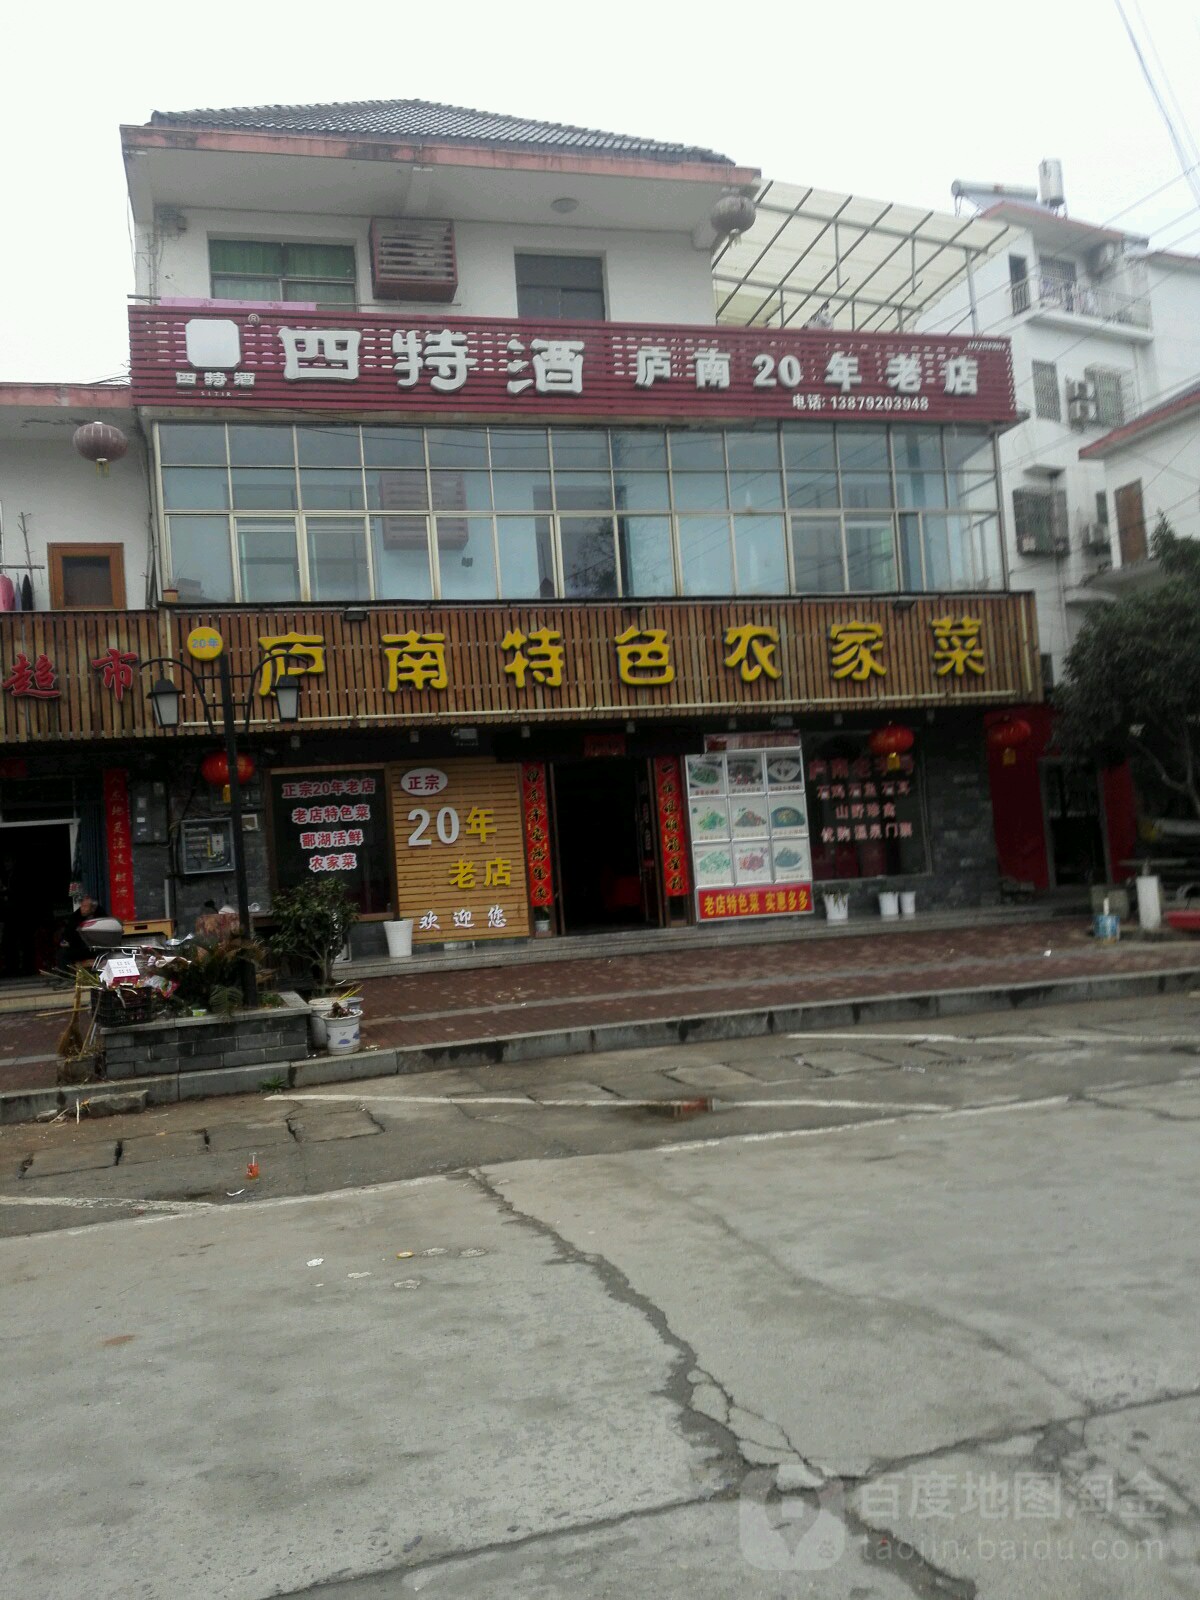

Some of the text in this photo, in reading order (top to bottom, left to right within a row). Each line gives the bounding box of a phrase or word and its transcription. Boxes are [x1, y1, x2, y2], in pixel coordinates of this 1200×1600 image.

[277, 326, 979, 395] 四特酒 庐南20年老店
[176, 372, 255, 387] 四特酒
[192, 638, 219, 648] 20年
[258, 615, 986, 696] 庐南特色农家菜
[1, 647, 137, 700] 超市
[282, 779, 376, 798] 正宗20年老店
[408, 775, 440, 790] 正宗
[292, 804, 371, 825] 老店特色菜
[408, 806, 497, 846] 20年
[300, 829, 363, 849] 鄱湖活鲜
[309, 853, 357, 872] 农家菜
[449, 857, 512, 888] 老店
[704, 889, 808, 915] 老店特色菜 实惠多多
[419, 905, 507, 929] 欢迎您
